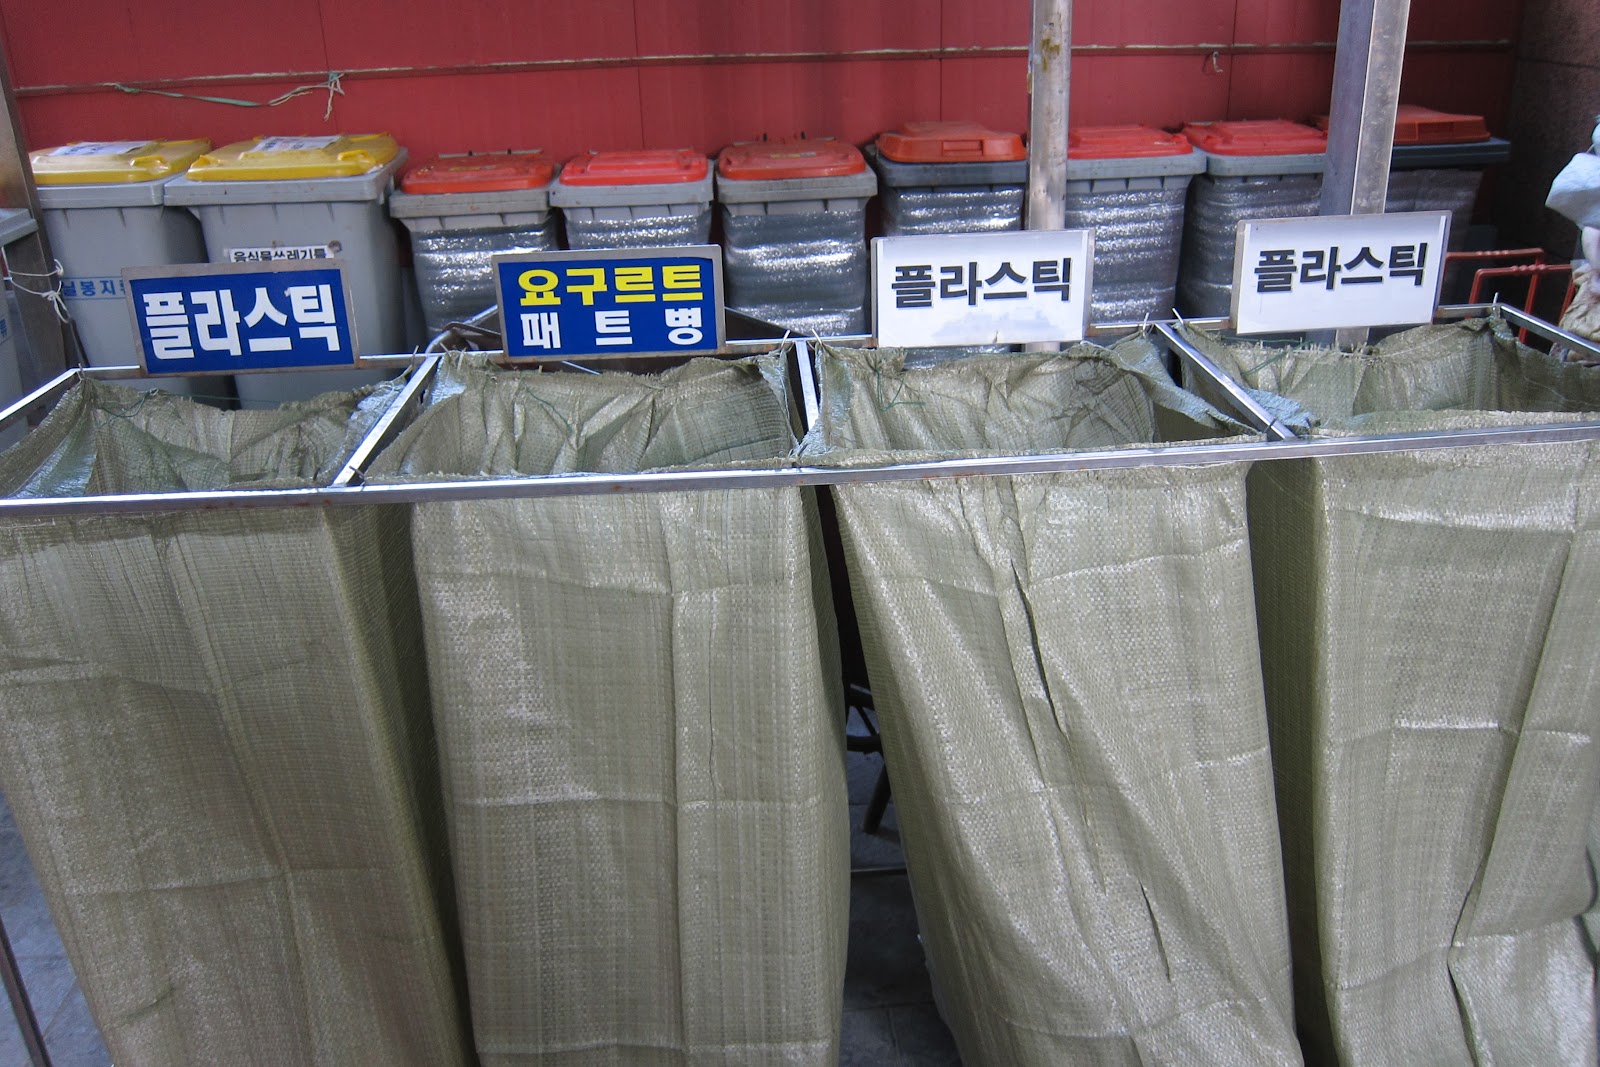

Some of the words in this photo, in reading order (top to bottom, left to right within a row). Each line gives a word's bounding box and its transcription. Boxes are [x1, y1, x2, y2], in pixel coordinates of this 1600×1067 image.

[518, 265, 703, 306] 요구르트
[891, 257, 1071, 308] 플라스틱
[1254, 242, 1428, 293] 플라스틱
[142, 284, 341, 360] 플라스틱
